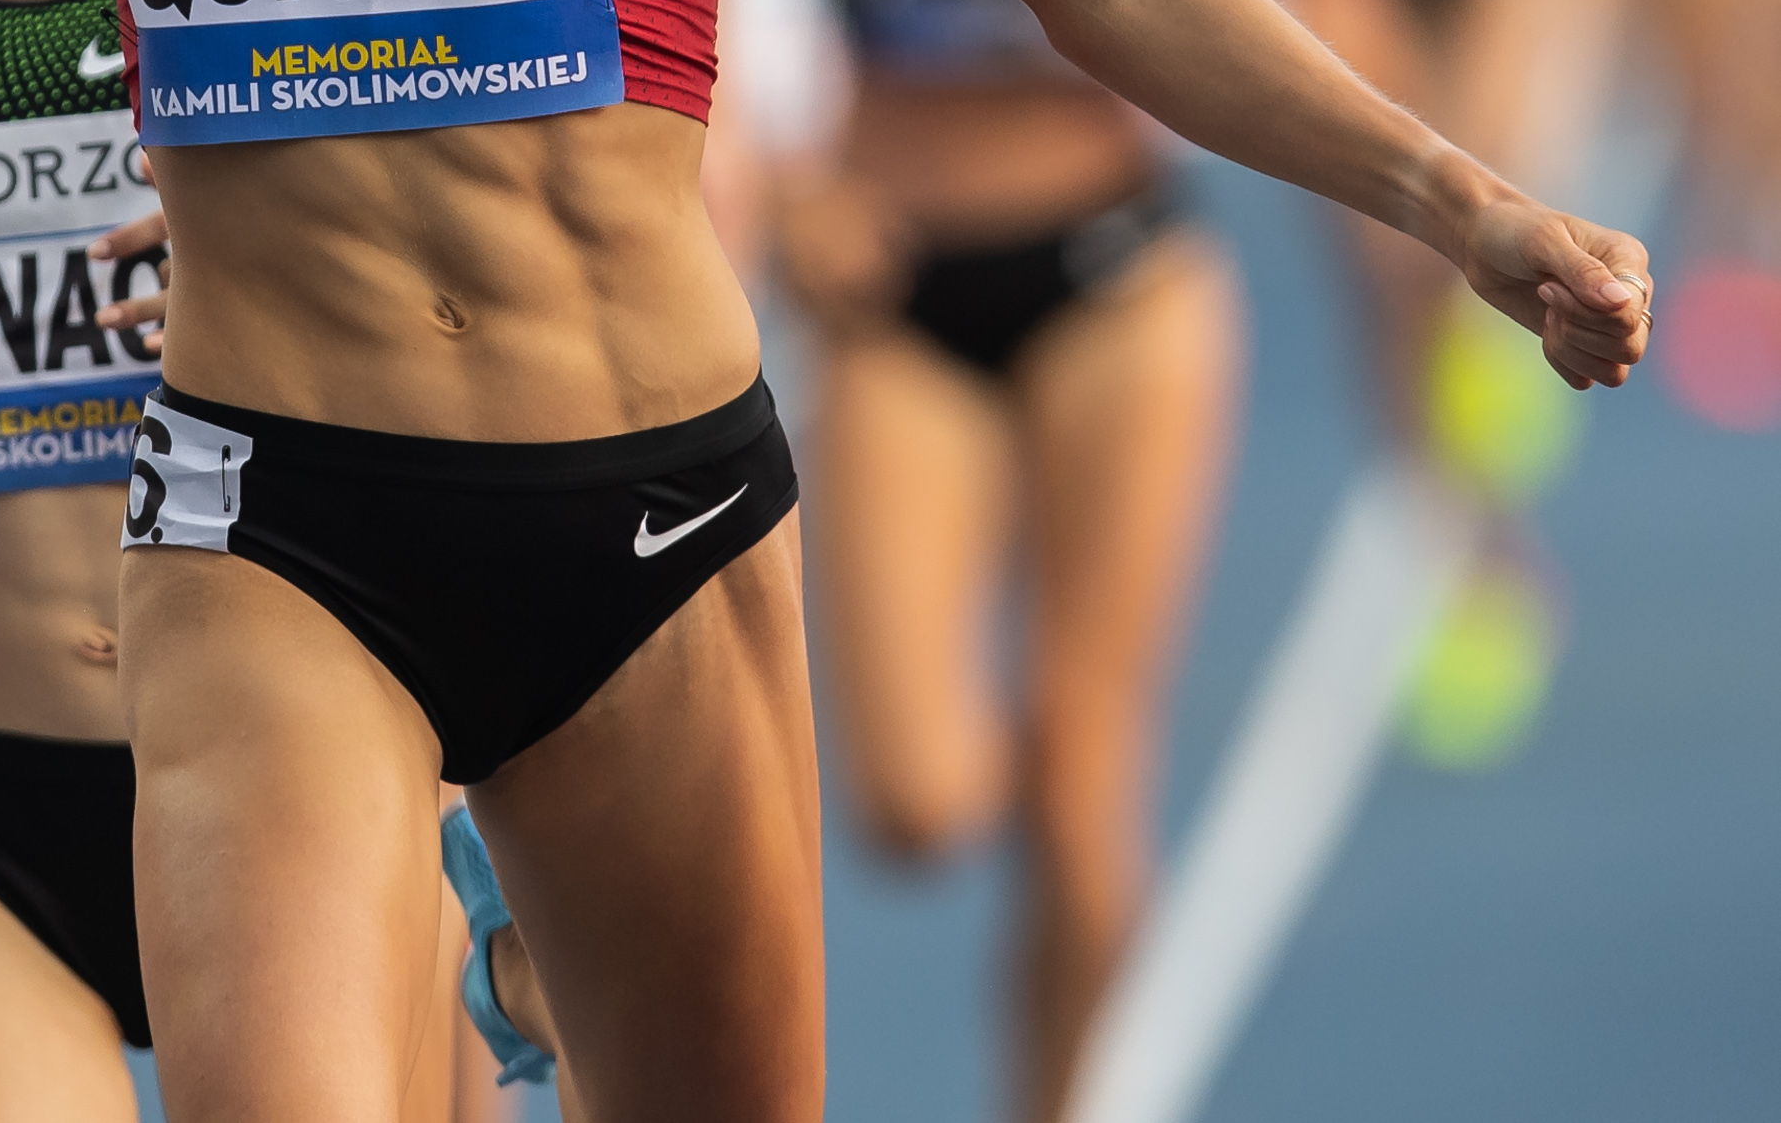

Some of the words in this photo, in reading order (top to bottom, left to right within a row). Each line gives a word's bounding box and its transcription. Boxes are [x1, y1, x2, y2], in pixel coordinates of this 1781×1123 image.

[252, 35, 458, 77] MEMORIAŁ
[151, 82, 260, 118] KAMILI
[272, 52, 587, 110] SKOLIMOWSKIEJ
